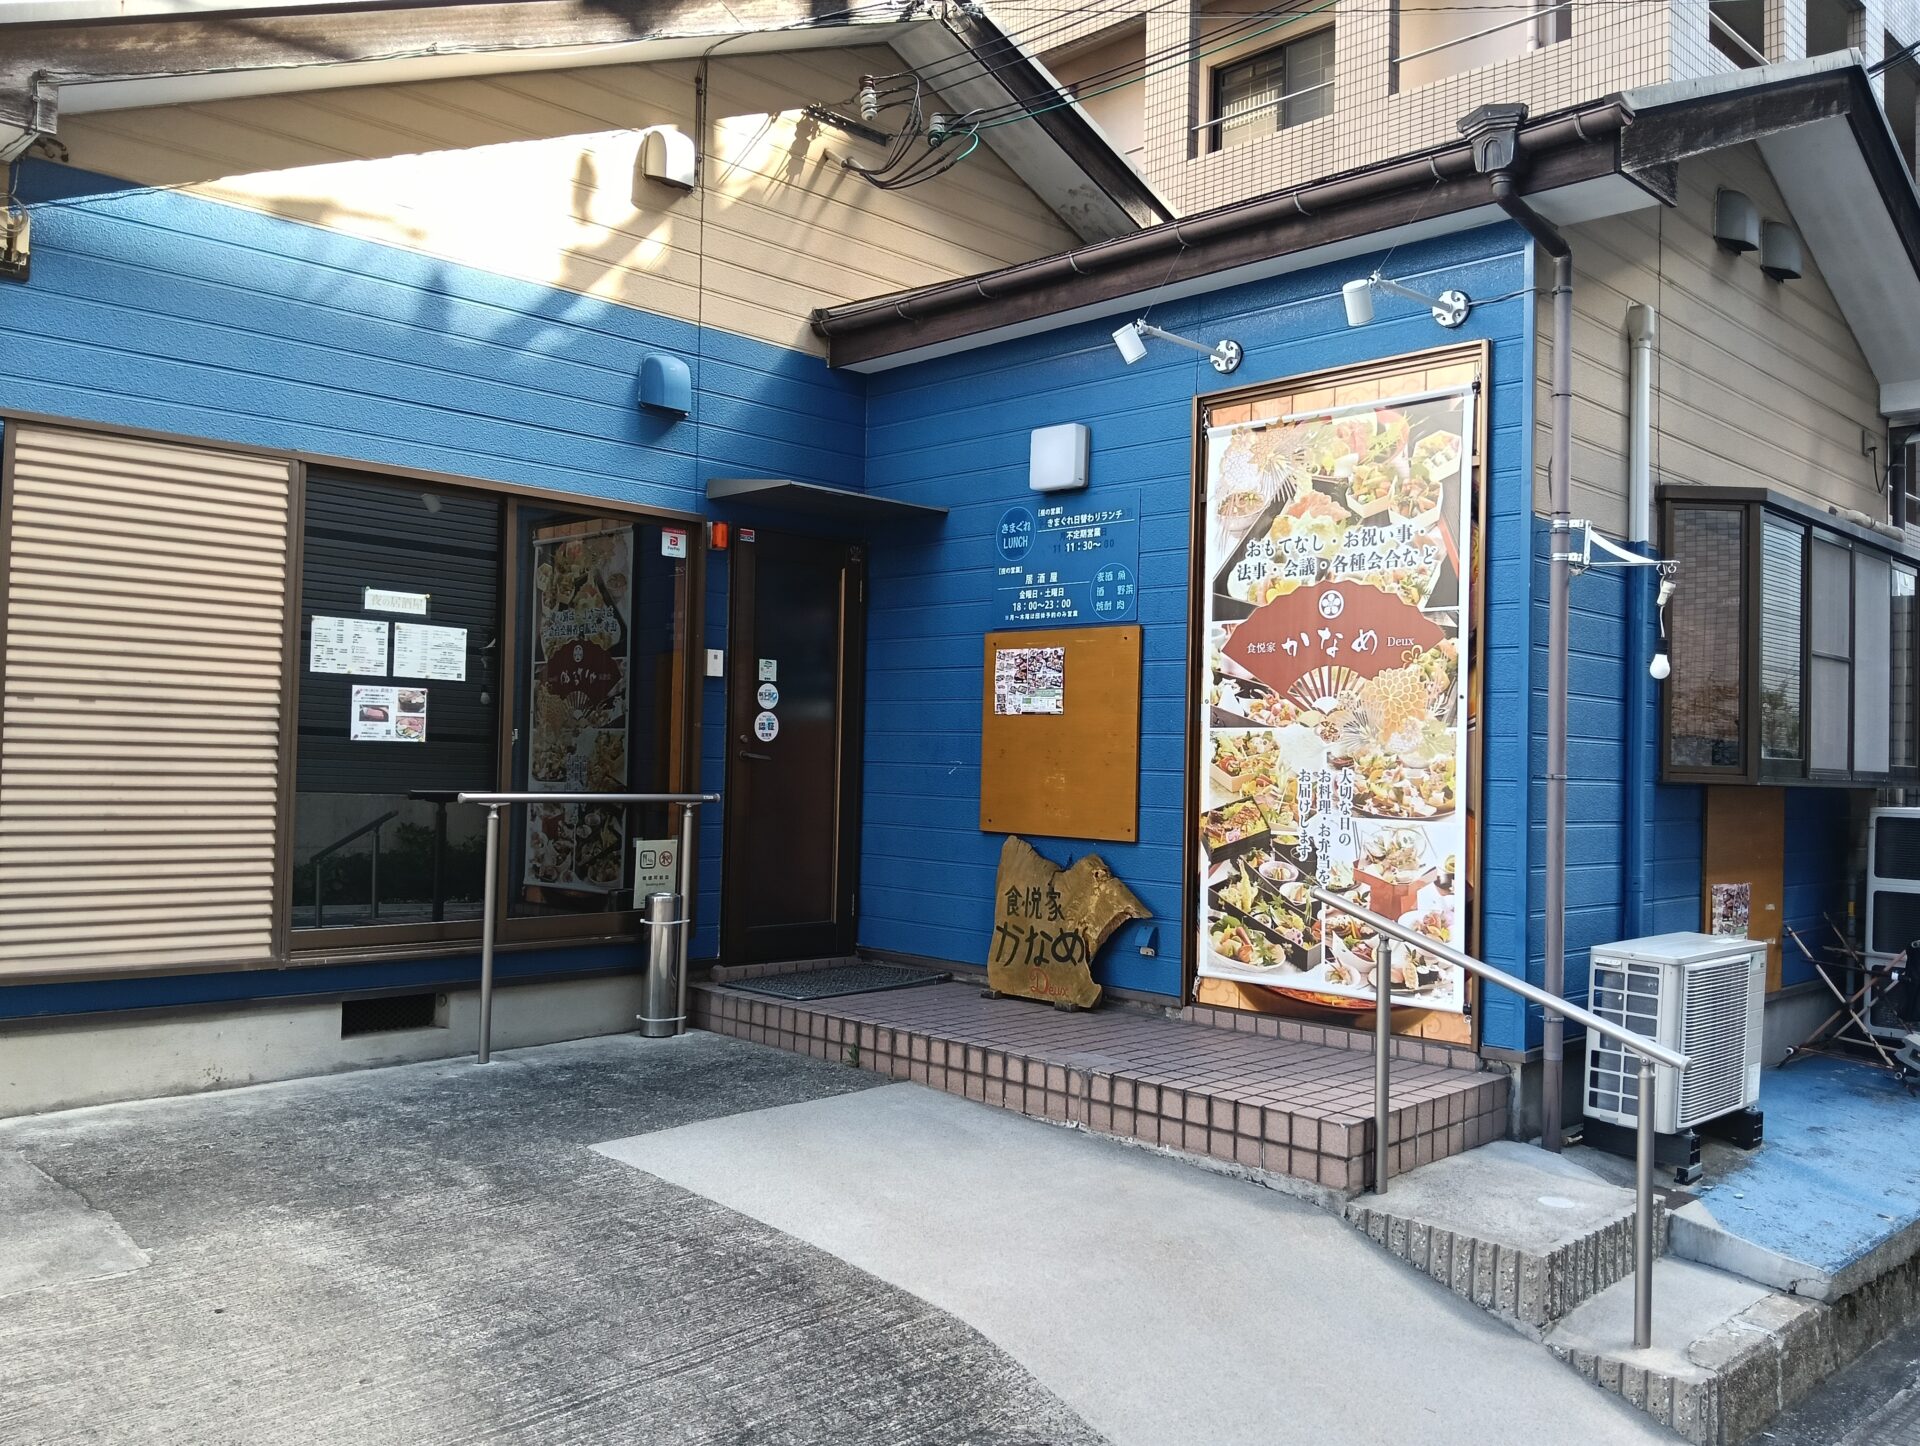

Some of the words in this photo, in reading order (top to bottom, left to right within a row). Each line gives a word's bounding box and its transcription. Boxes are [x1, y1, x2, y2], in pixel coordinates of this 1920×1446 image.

[1001, 520, 1031, 534] きまぐれ
[1047, 509, 1123, 527] きまぐれ日替わりランチ
[1003, 535, 1029, 549] LUNCH
[1066, 527, 1101, 540] 不定期営業
[1237, 546, 1437, 582] 法事・会議・各種会合など
[1019, 587, 1064, 599] 金曜日・土曜日
[1116, 600, 1125, 610] 肉
[1247, 642, 1276, 654] 食悦家
[1281, 627, 1378, 658] かなめ
[1387, 636, 1415, 647] Deux
[1298, 768, 1312, 859] お届けします
[1339, 768, 1352, 846] 大切な日の
[1318, 769, 1332, 885] お料理・お弁当を
[1004, 884, 1065, 922] 食悦家
[995, 921, 1088, 967] かなめ
[1029, 967, 1069, 997] Deux
